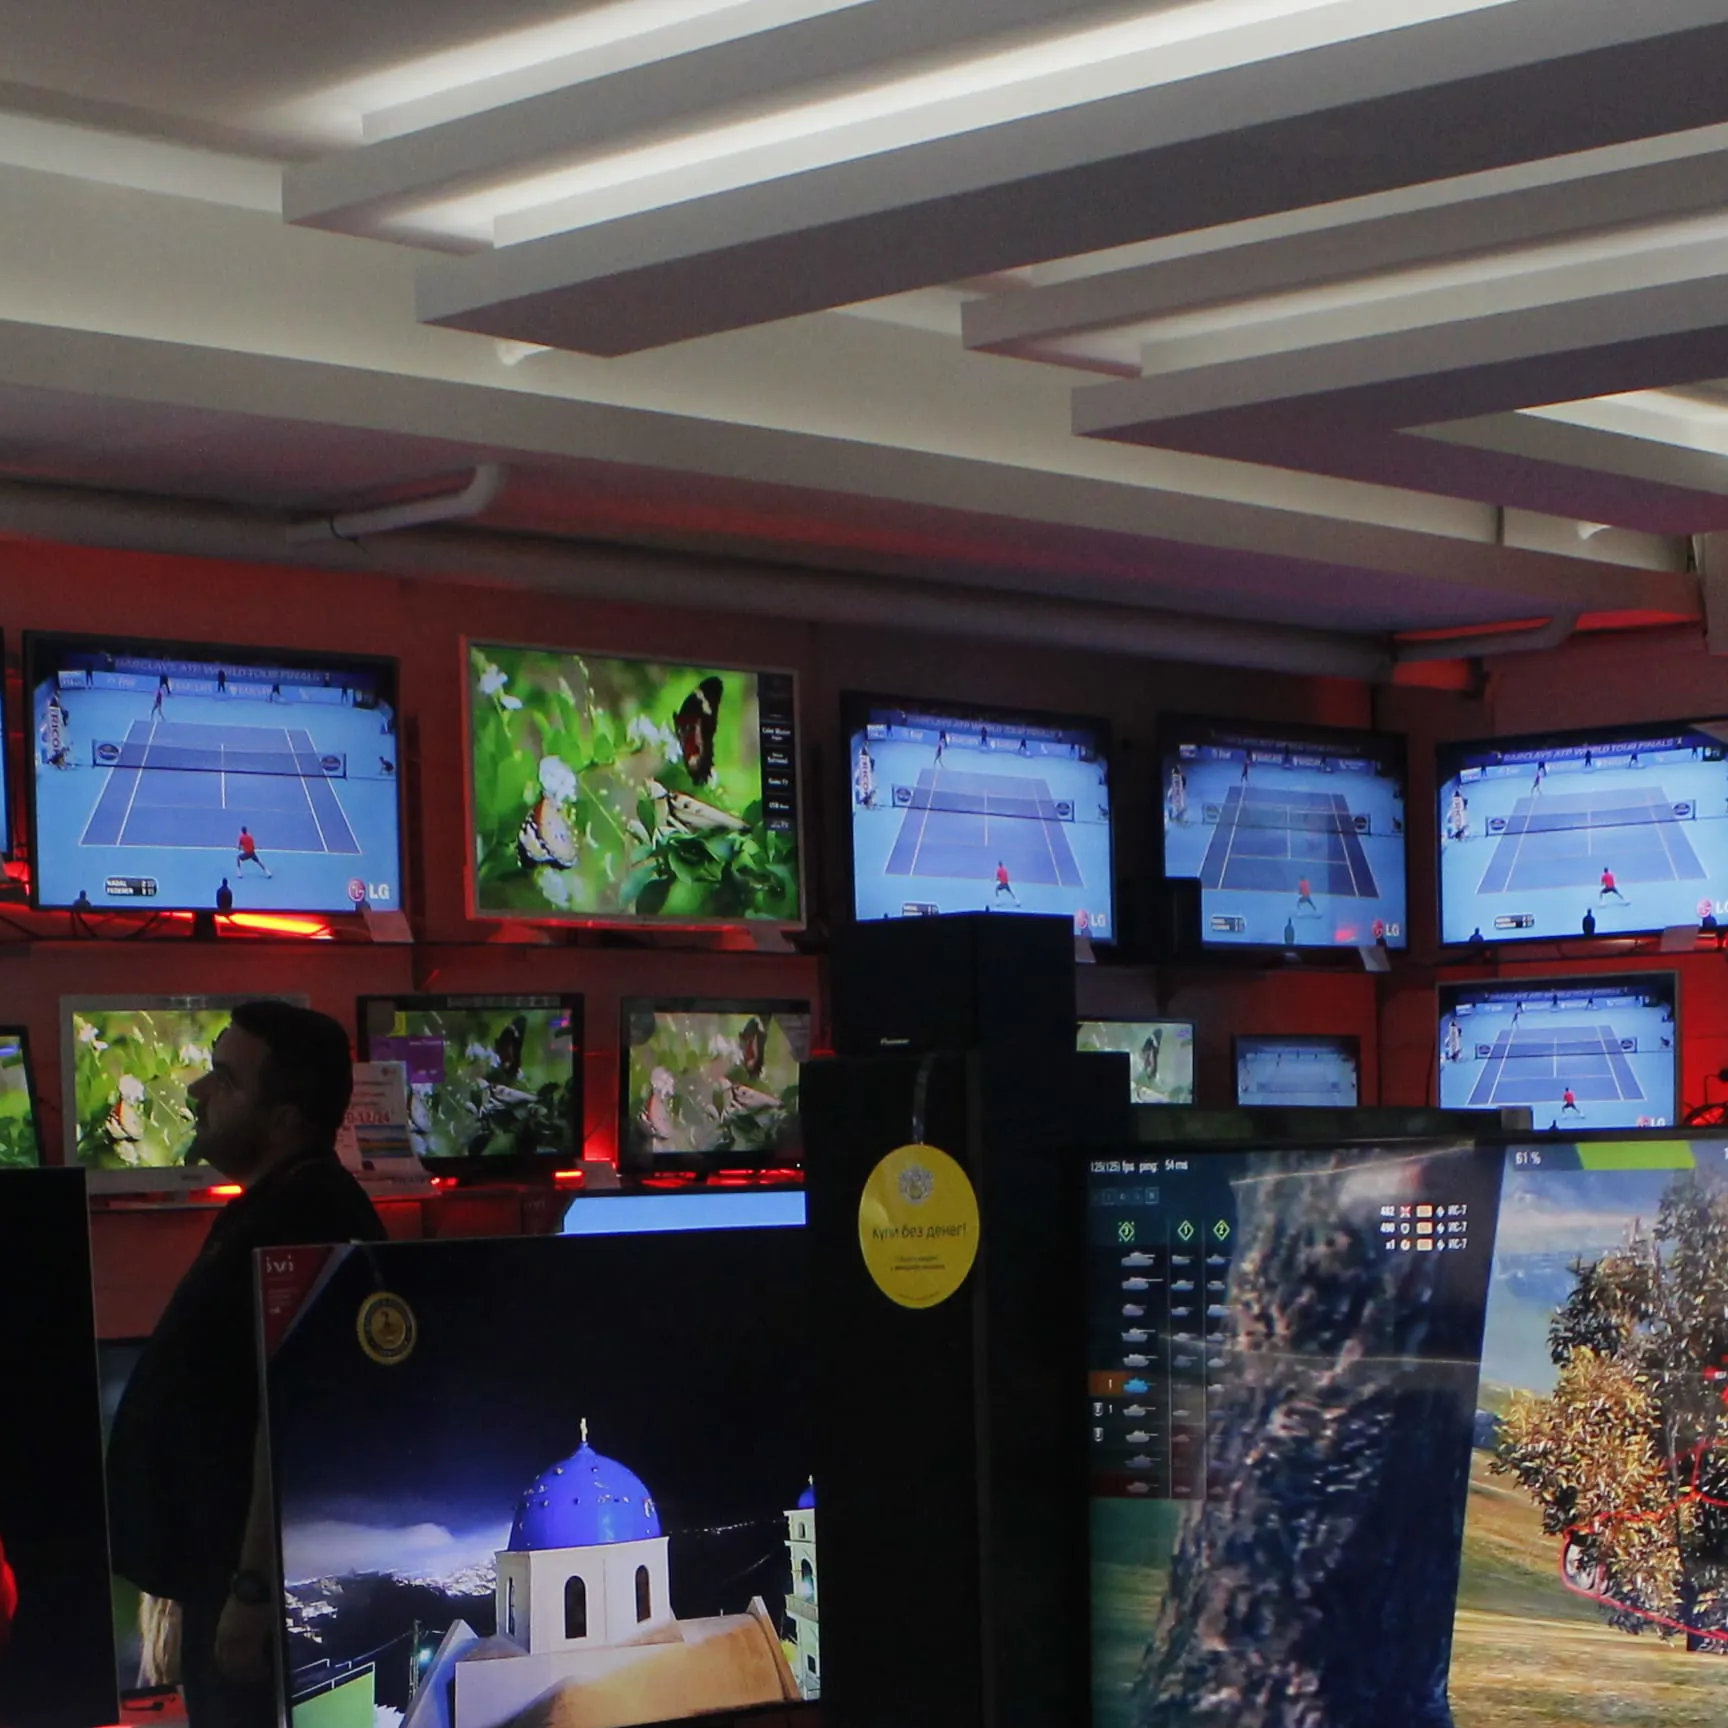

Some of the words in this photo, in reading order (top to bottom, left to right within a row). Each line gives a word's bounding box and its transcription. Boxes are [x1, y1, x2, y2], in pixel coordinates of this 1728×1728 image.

[367, 882, 390, 900] LG
[1091, 914, 1107, 927] LG
[1385, 923, 1400, 937] LG
[1514, 1151, 1530, 1165] 61
[872, 1226, 900, 1241] Купи
[901, 1224, 924, 1239] без
[925, 1222, 967, 1240] денег!
